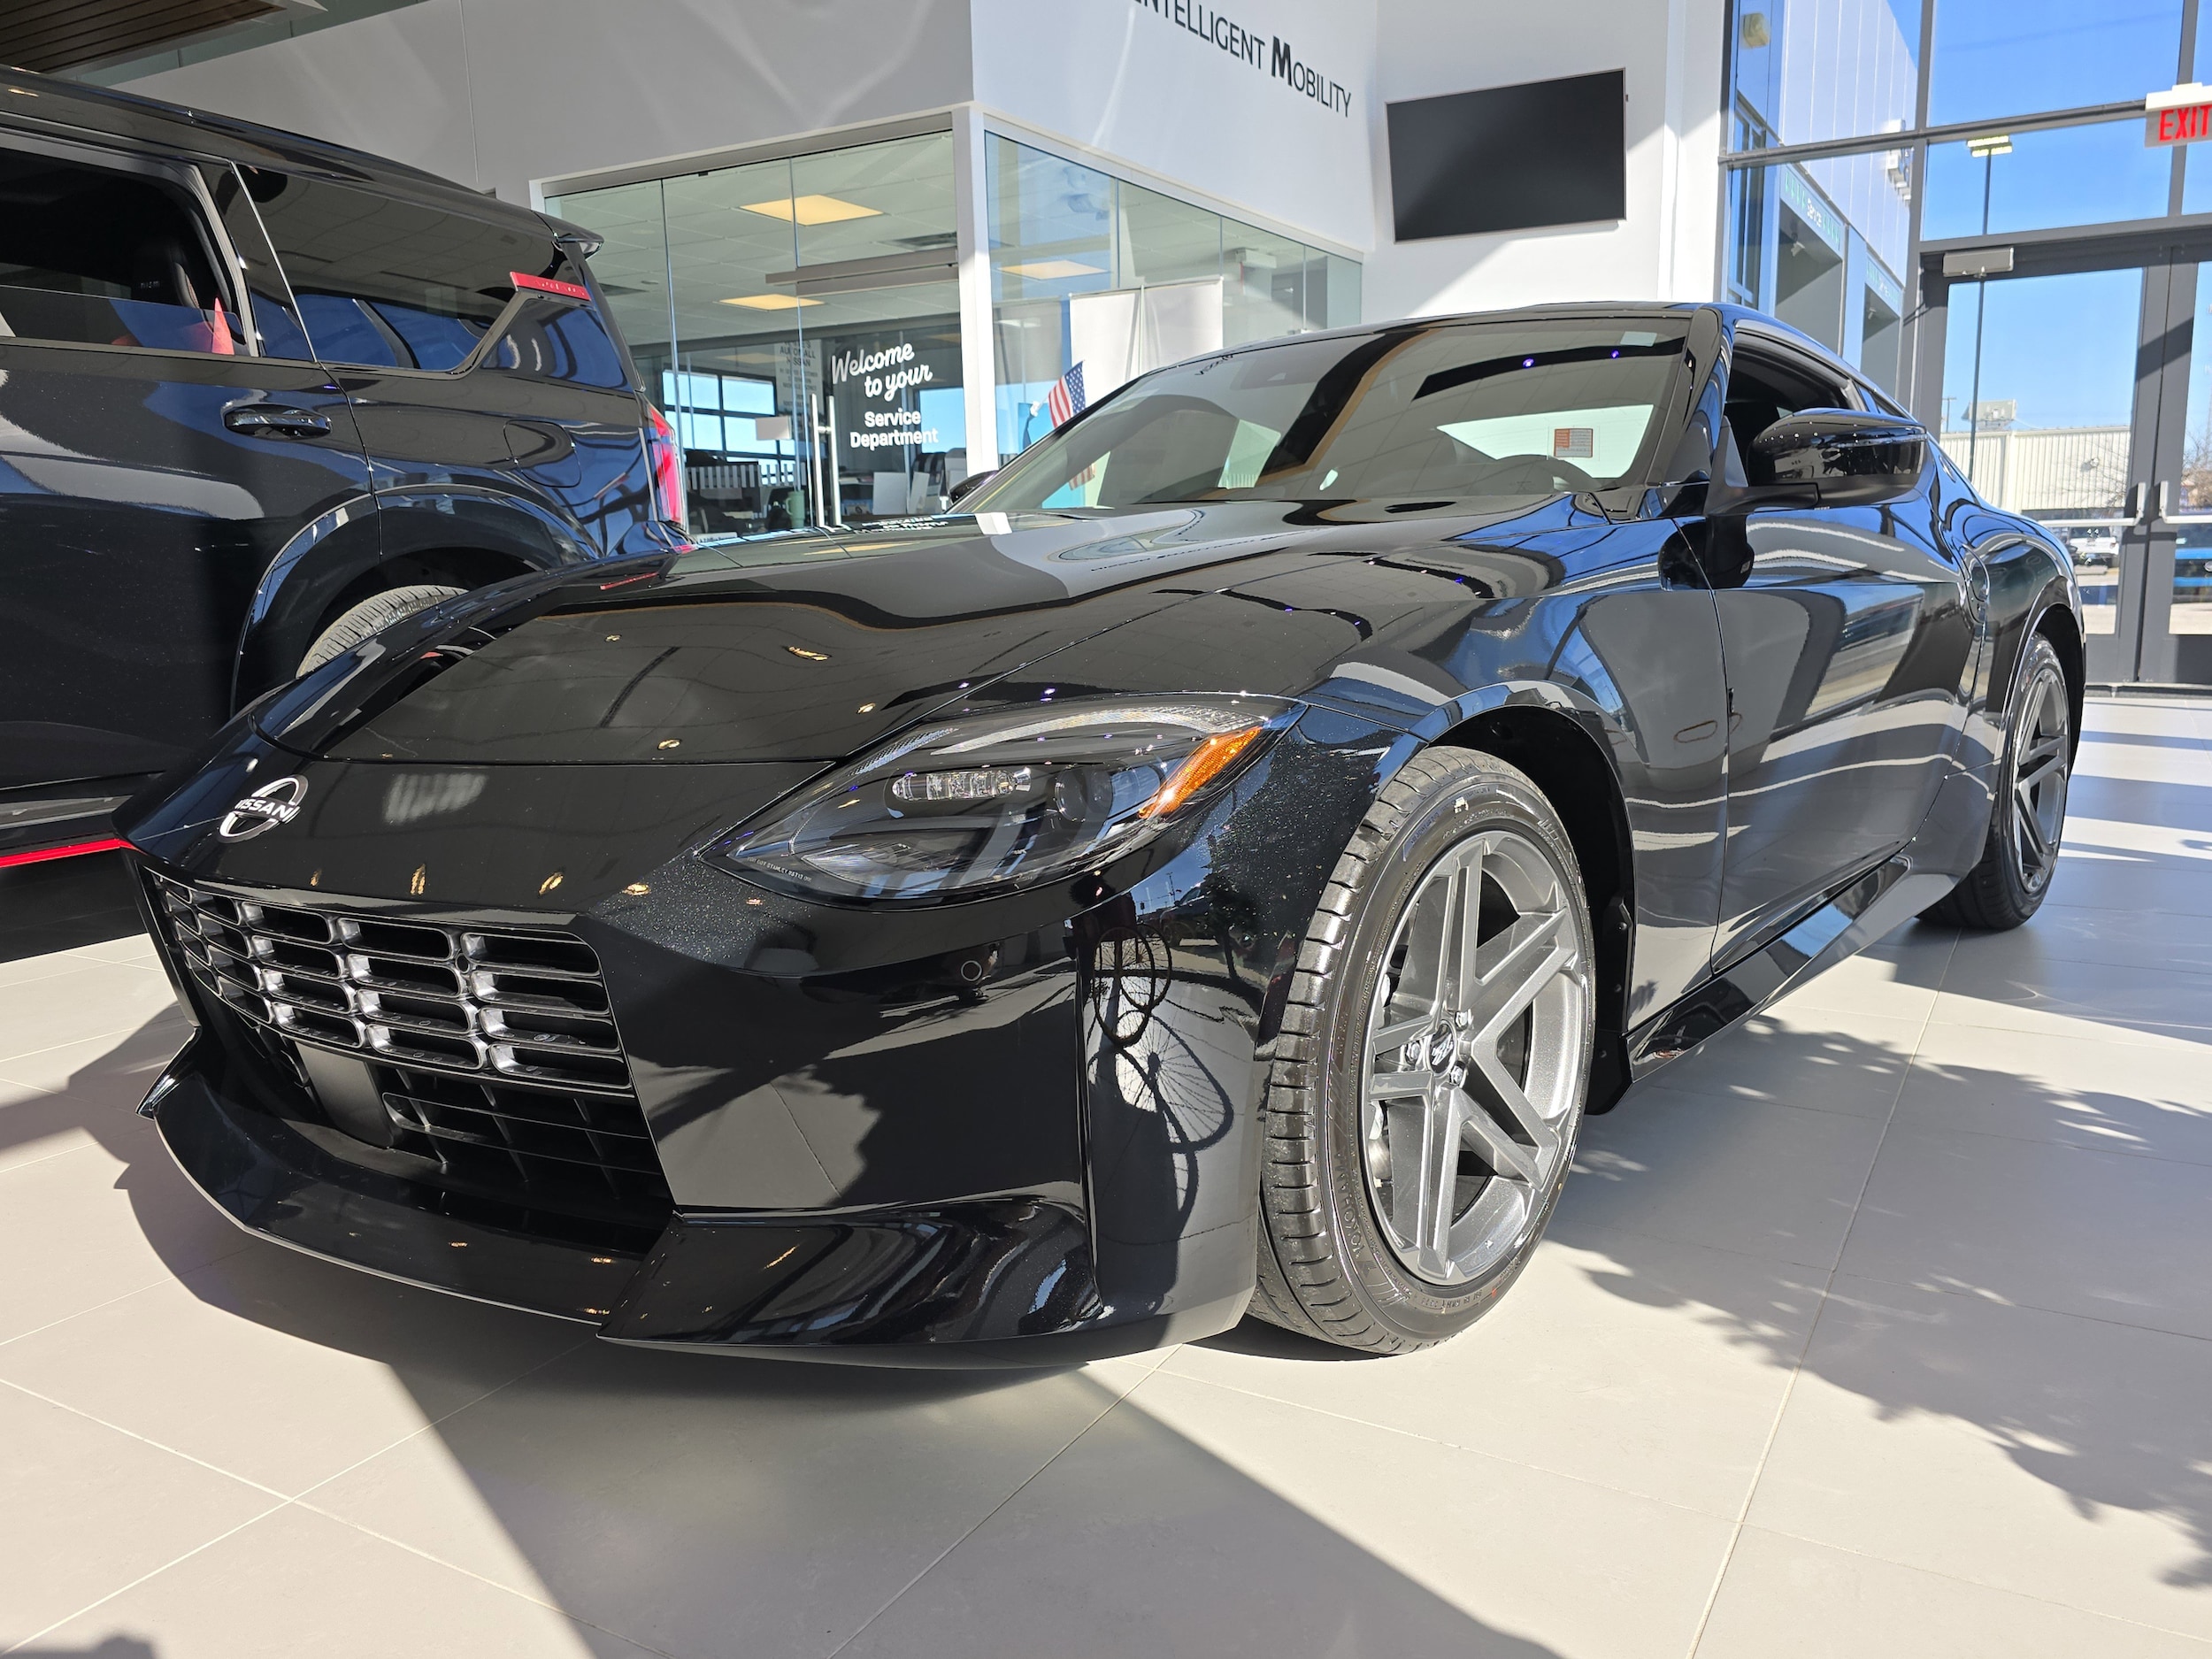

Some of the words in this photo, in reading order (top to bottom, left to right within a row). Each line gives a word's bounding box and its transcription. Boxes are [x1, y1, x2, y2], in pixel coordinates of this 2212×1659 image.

[1134, 0, 1265, 69] ELLIGENT
[1271, 35, 1351, 117] MOBILITY
[2159, 104, 2212, 142] EXIT
[832, 343, 915, 384] Welcome
[864, 376, 882, 398] to
[884, 364, 933, 402] your
[864, 407, 921, 428] Service
[849, 427, 939, 450] Department
